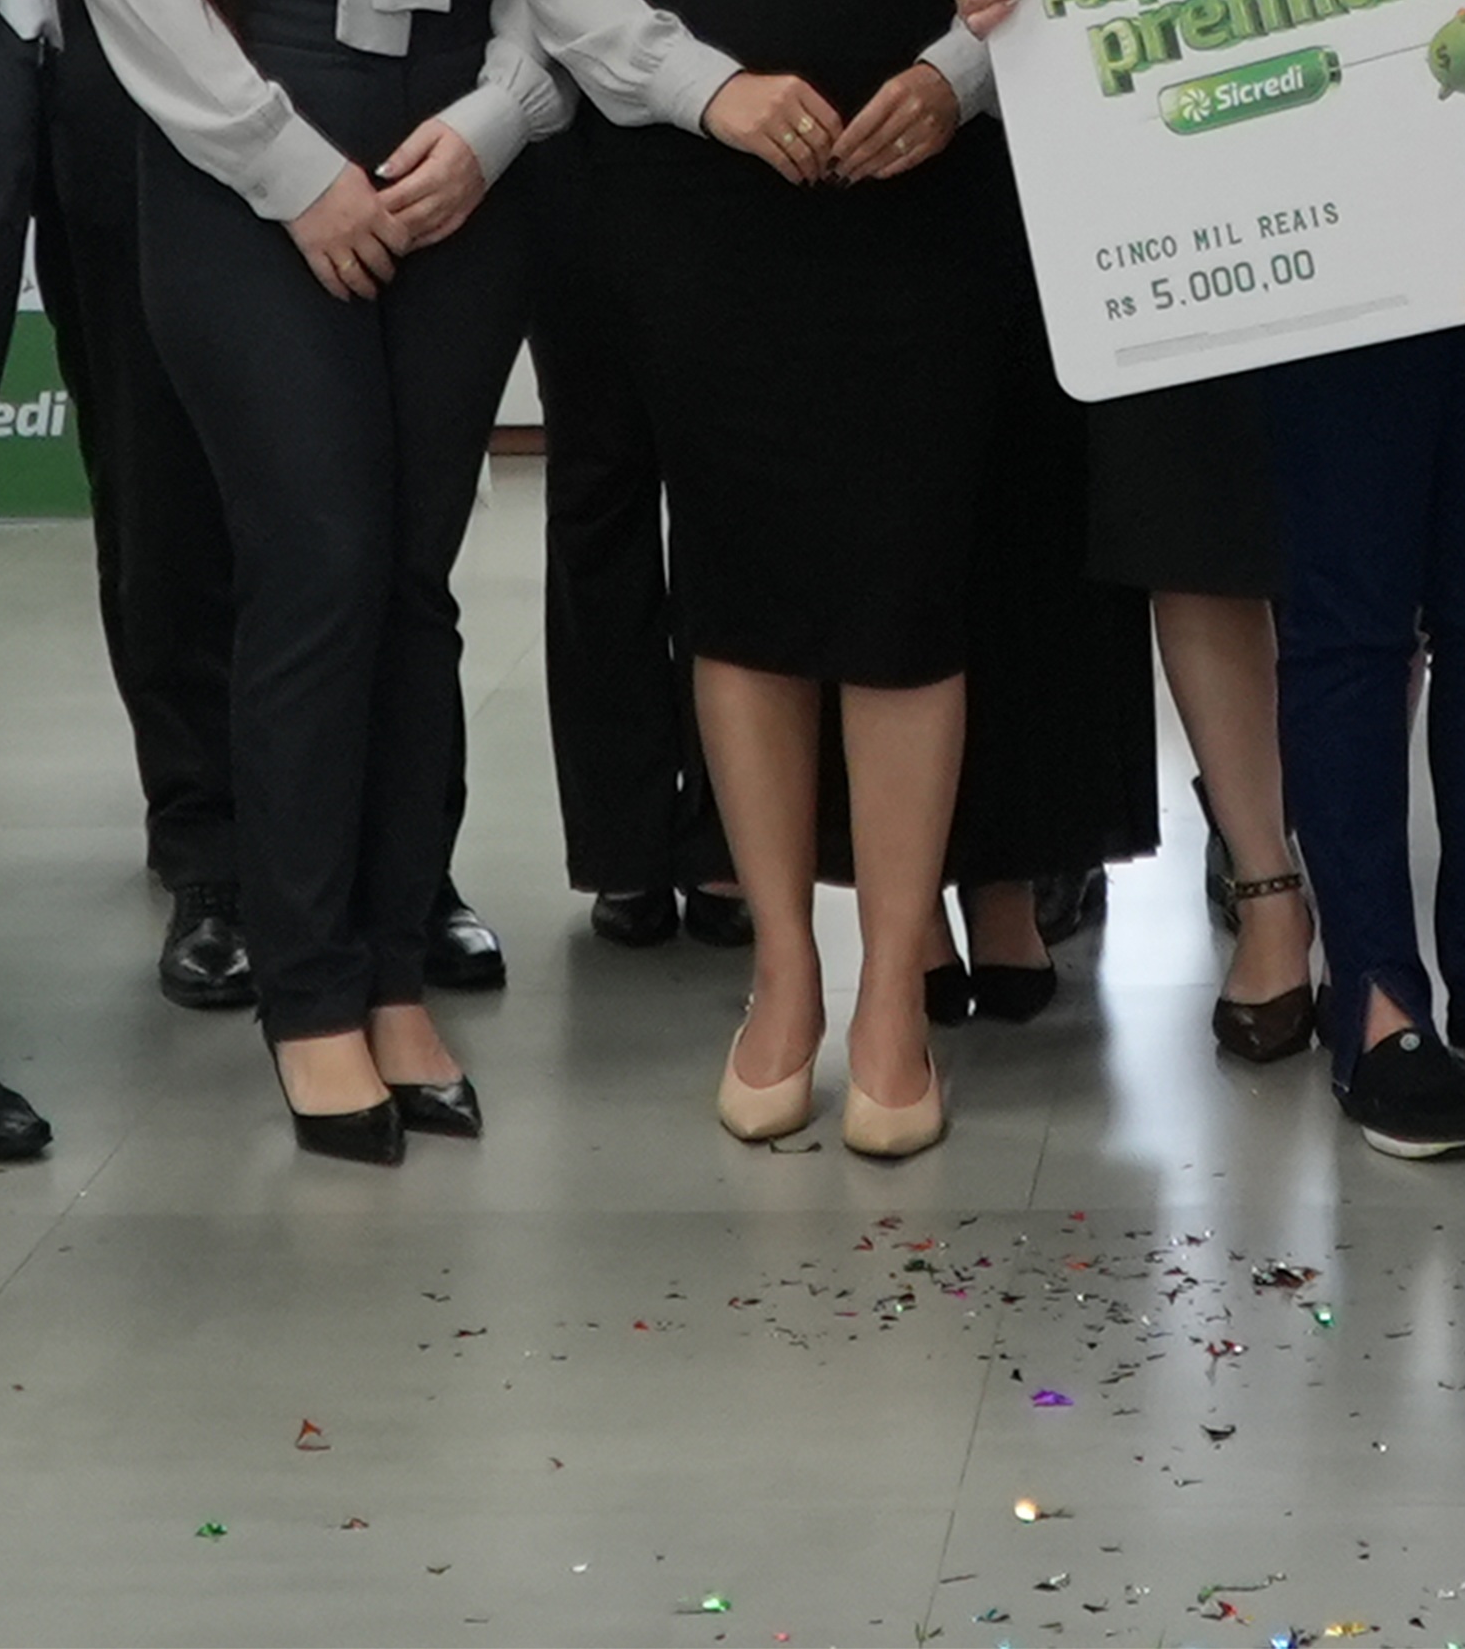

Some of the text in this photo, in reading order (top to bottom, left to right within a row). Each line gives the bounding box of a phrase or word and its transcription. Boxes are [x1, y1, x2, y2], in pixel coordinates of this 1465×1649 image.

[1213, 64, 1305, 113] Sicredi
[1095, 201, 1341, 272] CINCO MIL REAIS
[1104, 248, 1317, 321] R$ 5.000,00
